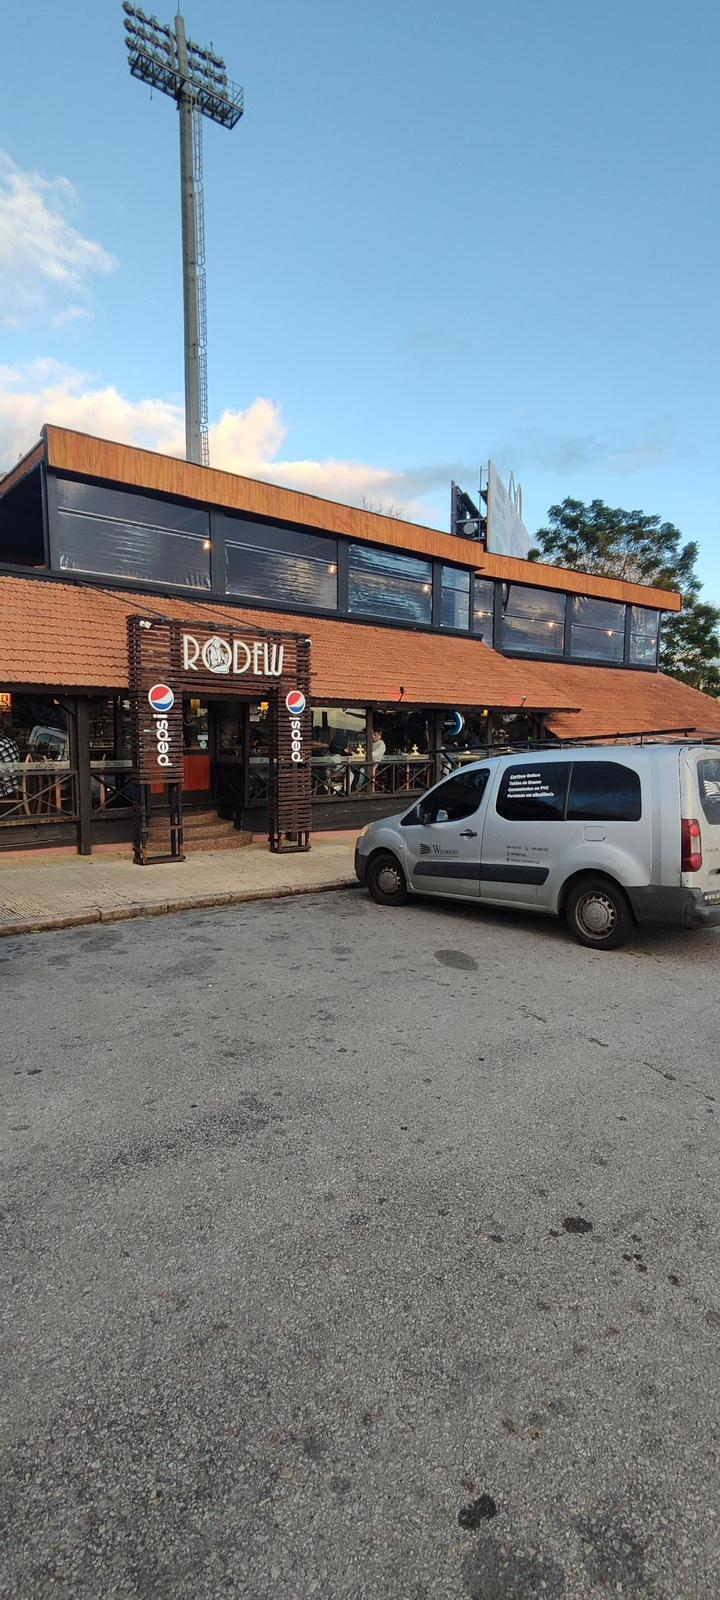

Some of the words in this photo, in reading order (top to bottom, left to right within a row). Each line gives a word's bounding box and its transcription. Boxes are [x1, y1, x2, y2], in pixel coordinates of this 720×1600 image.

[183, 634, 284, 676] RODELU
[152, 714, 173, 766] pepsi
[289, 717, 304, 763] pepsi
